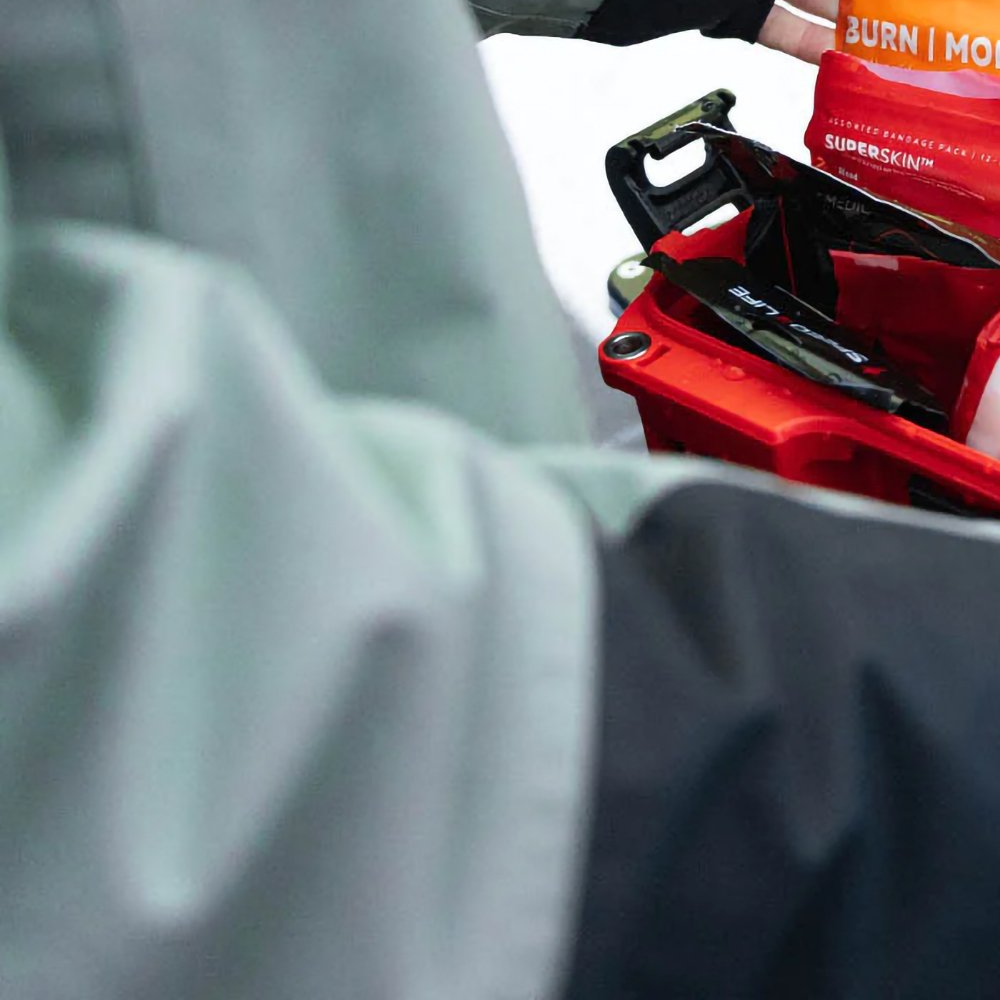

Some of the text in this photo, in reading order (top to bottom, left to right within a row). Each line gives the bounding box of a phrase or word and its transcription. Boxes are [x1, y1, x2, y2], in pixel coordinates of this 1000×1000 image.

[845, 15, 918, 56] BURN
[883, 130, 934, 149] BANDAGE
[938, 143, 967, 157] PACK
[728, 285, 780, 316] LIFE
